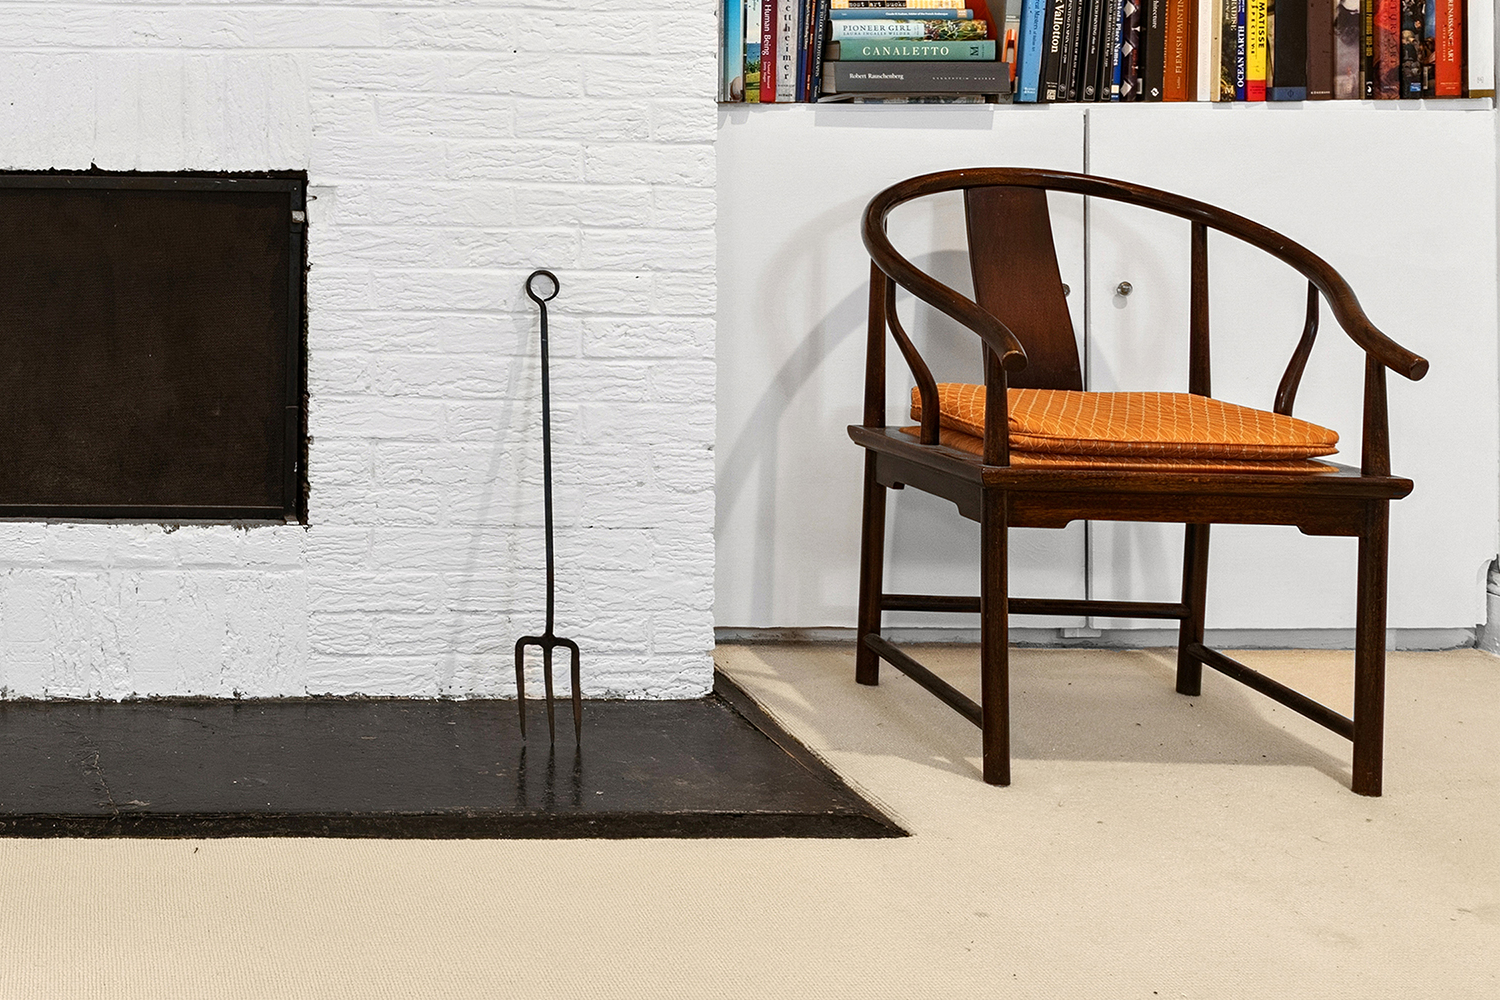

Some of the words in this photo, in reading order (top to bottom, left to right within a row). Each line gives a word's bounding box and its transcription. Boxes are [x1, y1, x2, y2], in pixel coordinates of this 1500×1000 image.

[764, 4, 772, 31] Human
[1050, 4, 1064, 54] Vallotton
[1257, 2, 1266, 49] MATISSE
[762, 34, 772, 56] Being
[862, 46, 950, 56] CANALETTO
[868, 73, 904, 81] Rauschenberg
[1236, 55, 1245, 88] OCEAN
